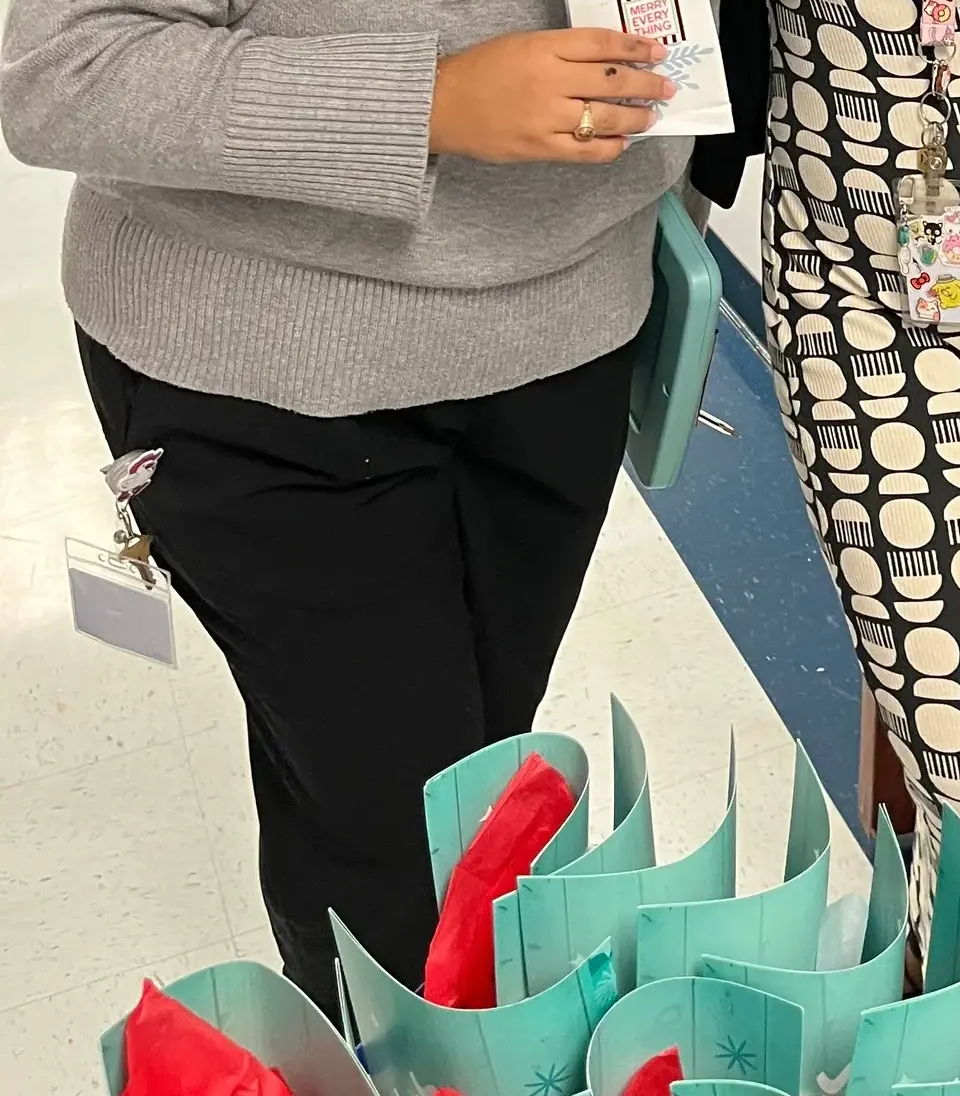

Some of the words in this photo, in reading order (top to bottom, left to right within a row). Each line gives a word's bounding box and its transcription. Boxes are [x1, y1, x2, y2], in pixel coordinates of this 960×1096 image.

[630, 0, 668, 16] MERRY
[632, 9, 669, 28] EVERY
[634, 20, 672, 36] THING
